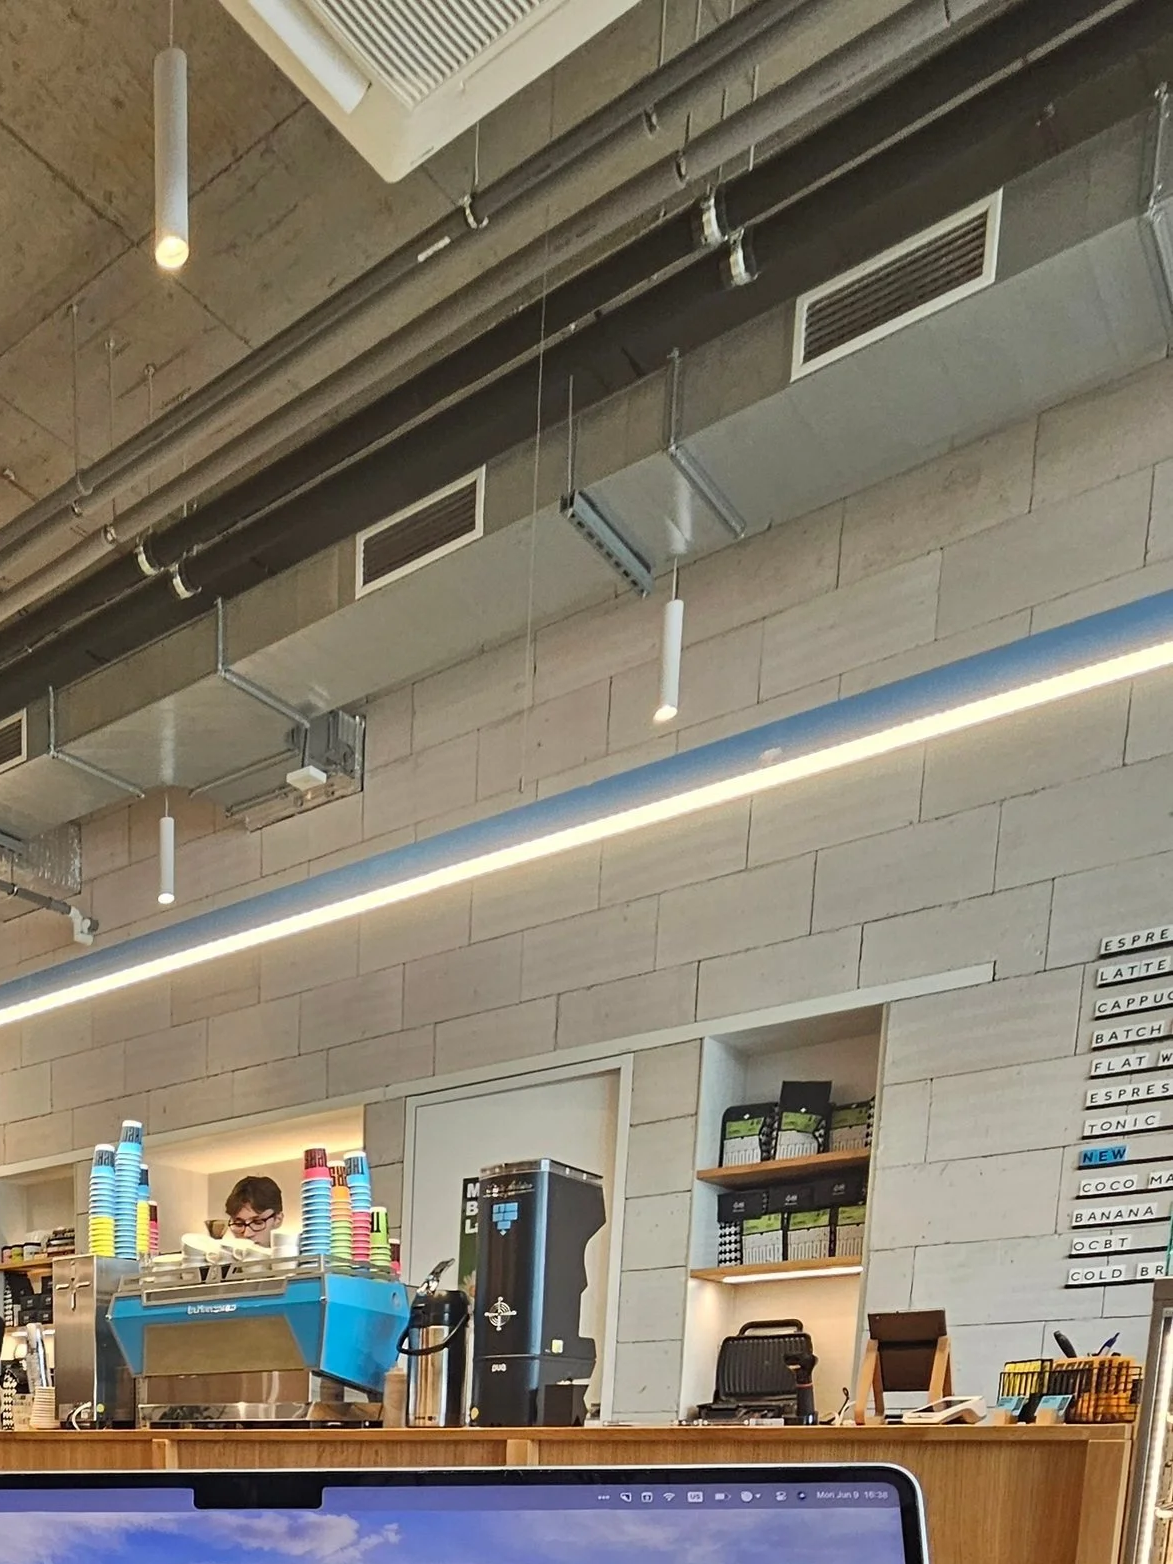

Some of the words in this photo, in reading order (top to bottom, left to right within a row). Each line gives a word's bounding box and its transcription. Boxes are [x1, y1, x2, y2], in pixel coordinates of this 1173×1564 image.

[1104, 928, 1169, 951] ESPRE
[1100, 959, 1167, 981] LATTE
[1095, 1024, 1162, 1044] BATCH
[1094, 1055, 1146, 1072] FLAT
[1090, 1083, 1170, 1104] ESPRES
[1088, 1115, 1156, 1134] TONIC
[1082, 1147, 1126, 1163] NEW
[1082, 1179, 1135, 1193] COCO
[1074, 1206, 1154, 1223] BANANA
[1073, 1238, 1128, 1251] OCBT
[1070, 1268, 1122, 1282] COLD
[1140, 1265, 1164, 1277] BR
